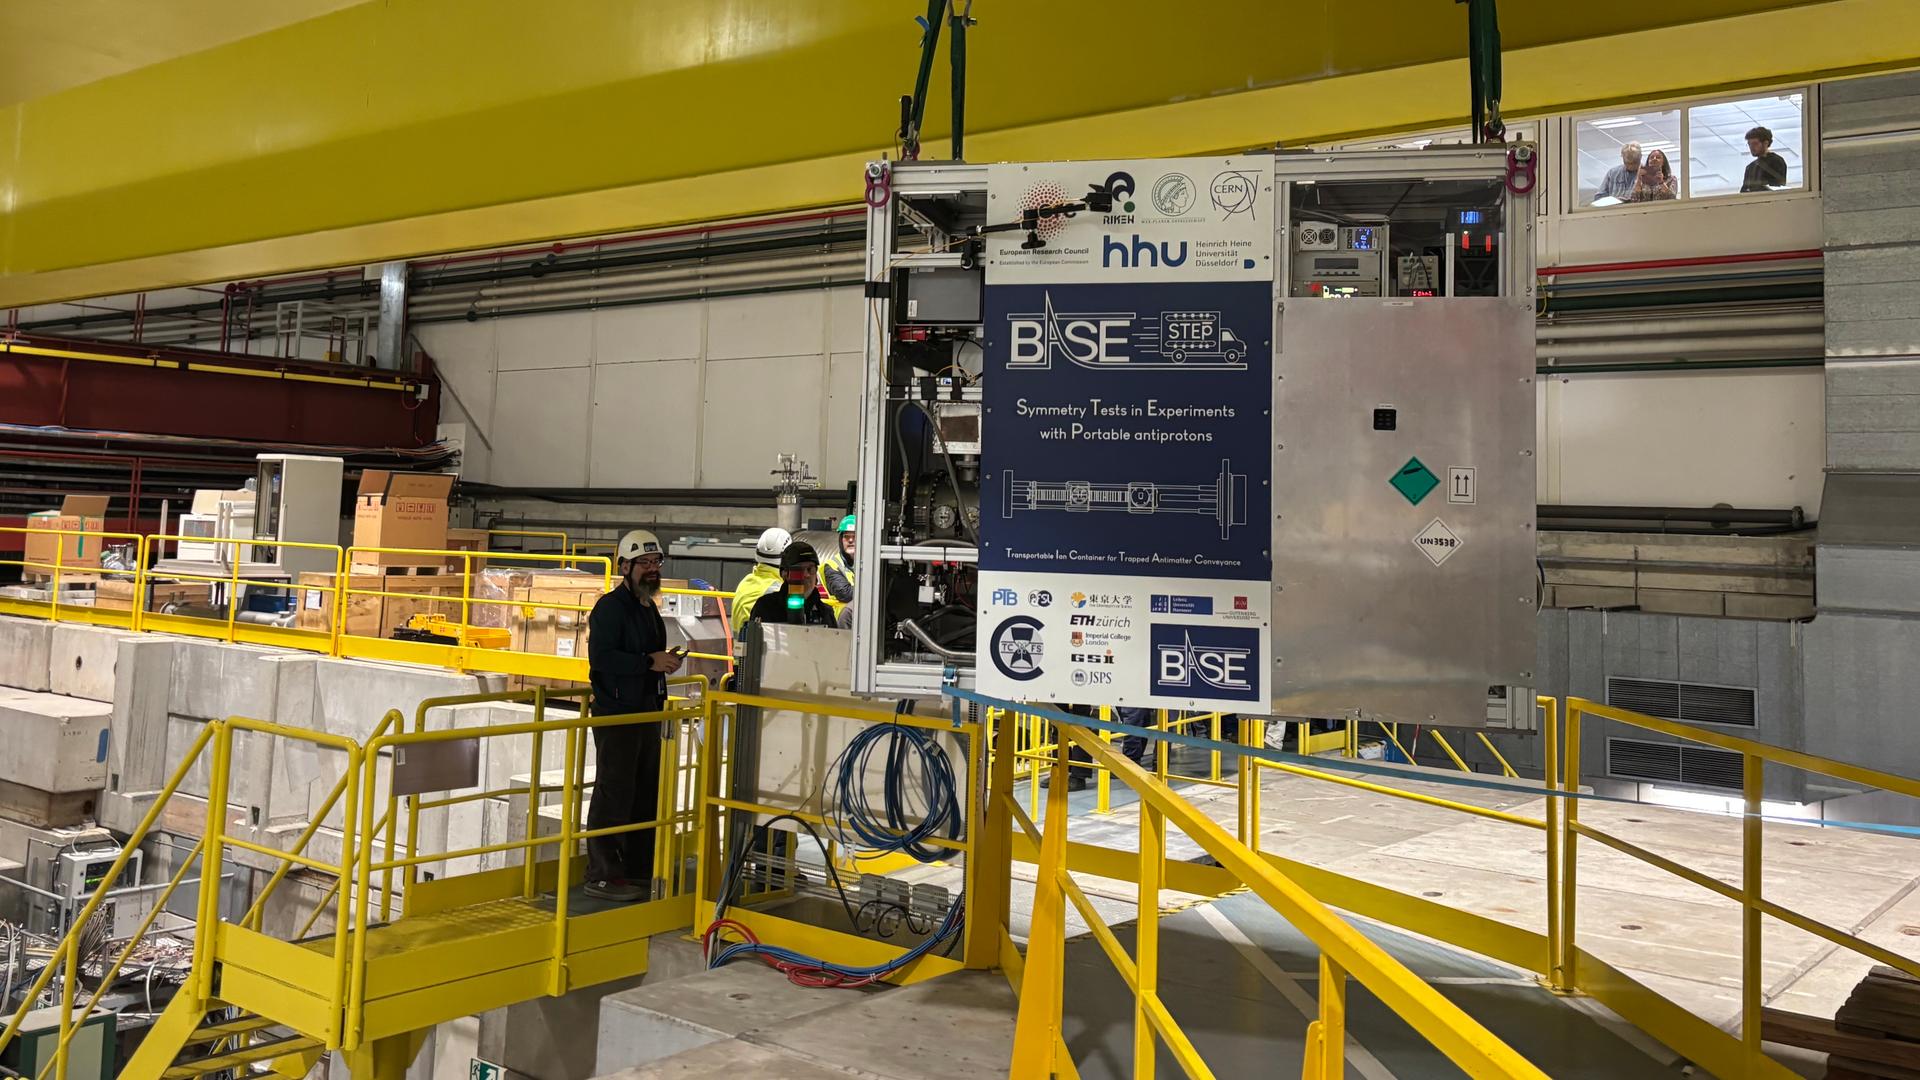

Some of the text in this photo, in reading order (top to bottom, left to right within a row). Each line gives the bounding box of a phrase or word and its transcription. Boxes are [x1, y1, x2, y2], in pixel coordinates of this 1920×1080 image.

[1214, 184, 1243, 194] CERN
[1103, 215, 1135, 225] RIKEN
[1195, 239, 1252, 248] Heinrich Heine
[999, 248, 1031, 256] European
[1064, 247, 1089, 255] Council
[1102, 234, 1188, 267] hhu
[1195, 249, 1238, 258] Universität
[1195, 258, 1239, 267] Düsseldorf
[1010, 290, 1131, 364] BASE
[1016, 398, 1235, 419] Symmetry Tests in Experiments
[1039, 422, 1213, 444] with Portable antiprotons
[1420, 537, 1455, 547] UN3538
[1005, 547, 1241, 567] Transportable Ion Container for Trapped Antimatter Conveyance
[992, 588, 1018, 606] PTB
[1089, 594, 1133, 605] 東京大学
[1070, 614, 1131, 628] ETH zürich
[1085, 632, 1132, 642] Imperial College
[1001, 643, 1014, 652] TC
[1031, 644, 1042, 653] FS
[1160, 629, 1247, 686] BASE
[1088, 671, 1112, 686] JSPS
